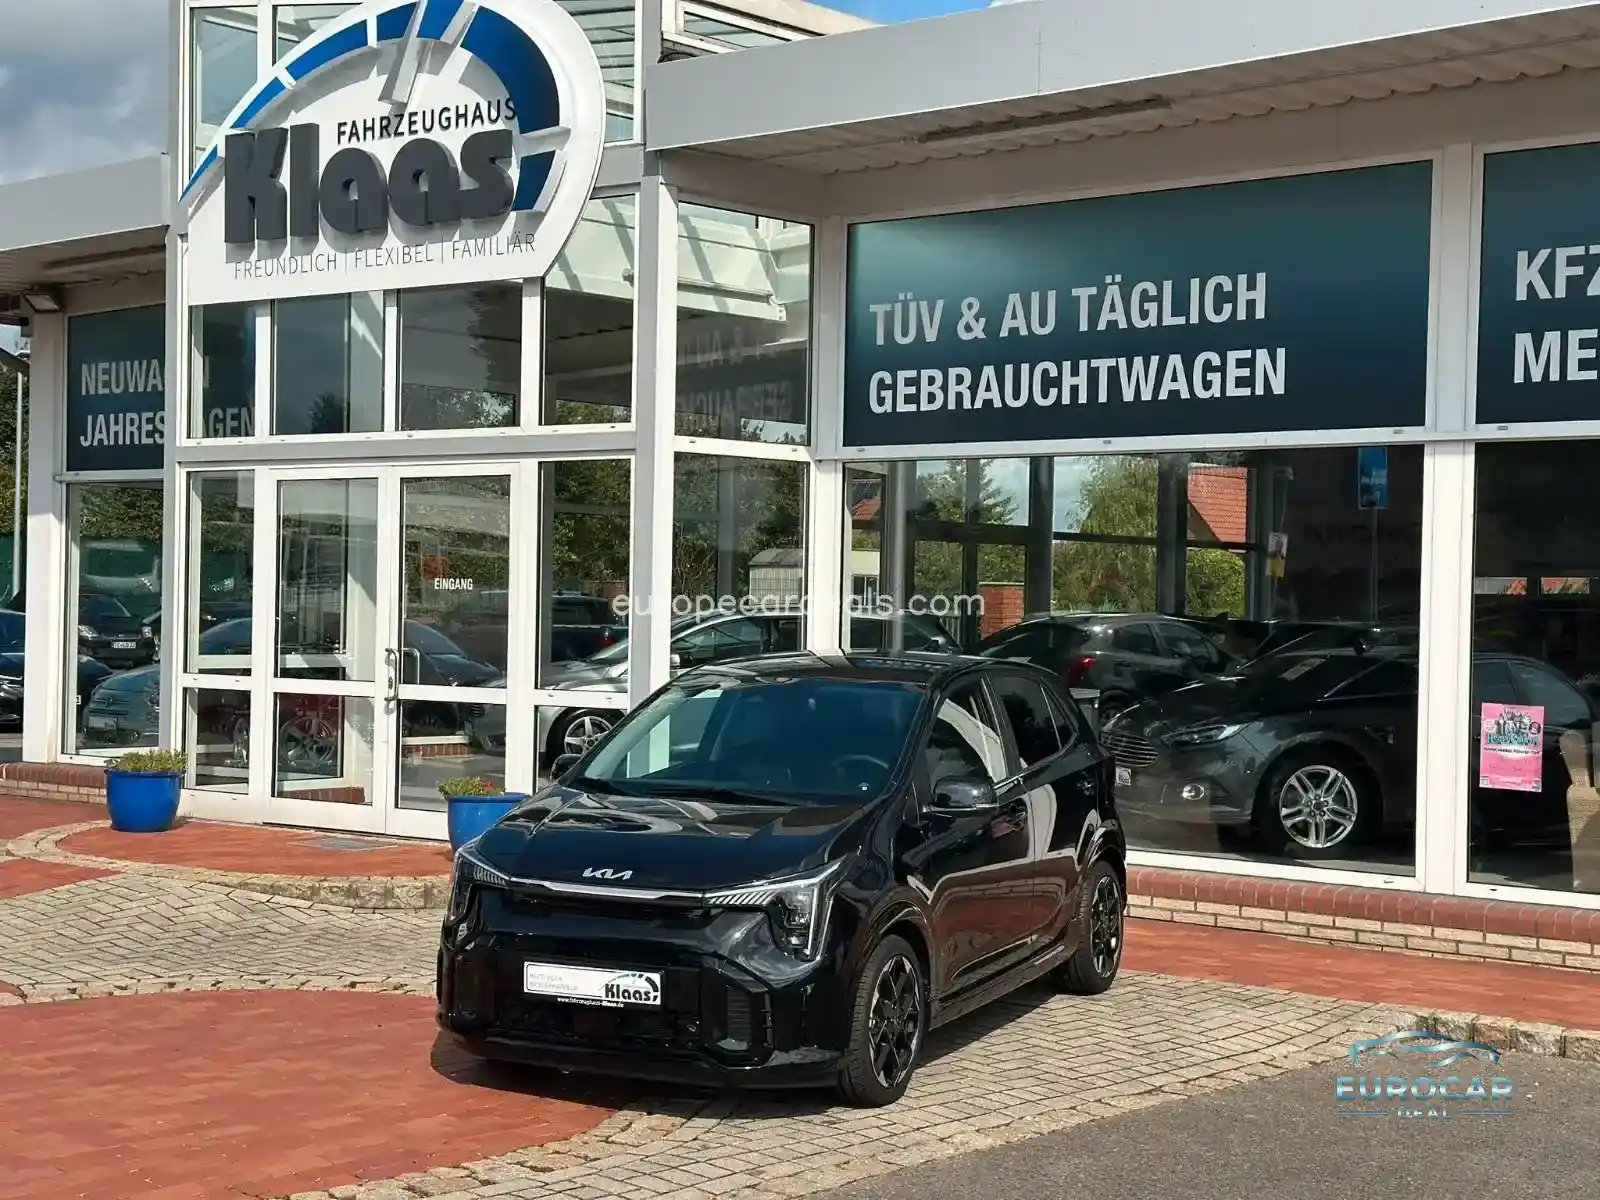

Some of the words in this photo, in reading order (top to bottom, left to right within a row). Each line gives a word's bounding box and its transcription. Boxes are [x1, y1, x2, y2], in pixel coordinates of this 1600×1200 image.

[336, 97, 517, 146] FAHRZEUGHAUS
[225, 122, 514, 244] Klaas
[234, 252, 337, 280] FREUNDLICH
[354, 243, 435, 268] FLEXIBEL
[451, 232, 536, 260] FAMILIÄR
[869, 292, 945, 347] TÜV
[956, 296, 988, 341] &
[999, 289, 1057, 338] AU
[1071, 272, 1268, 333] TÄGLICH
[868, 346, 1287, 415] GEBRAUCHTWAGEN
[80, 406, 256, 448] JAHRESGEN
[434, 577, 474, 590] EINGANG
[605, 984, 652, 1002] Klaas
